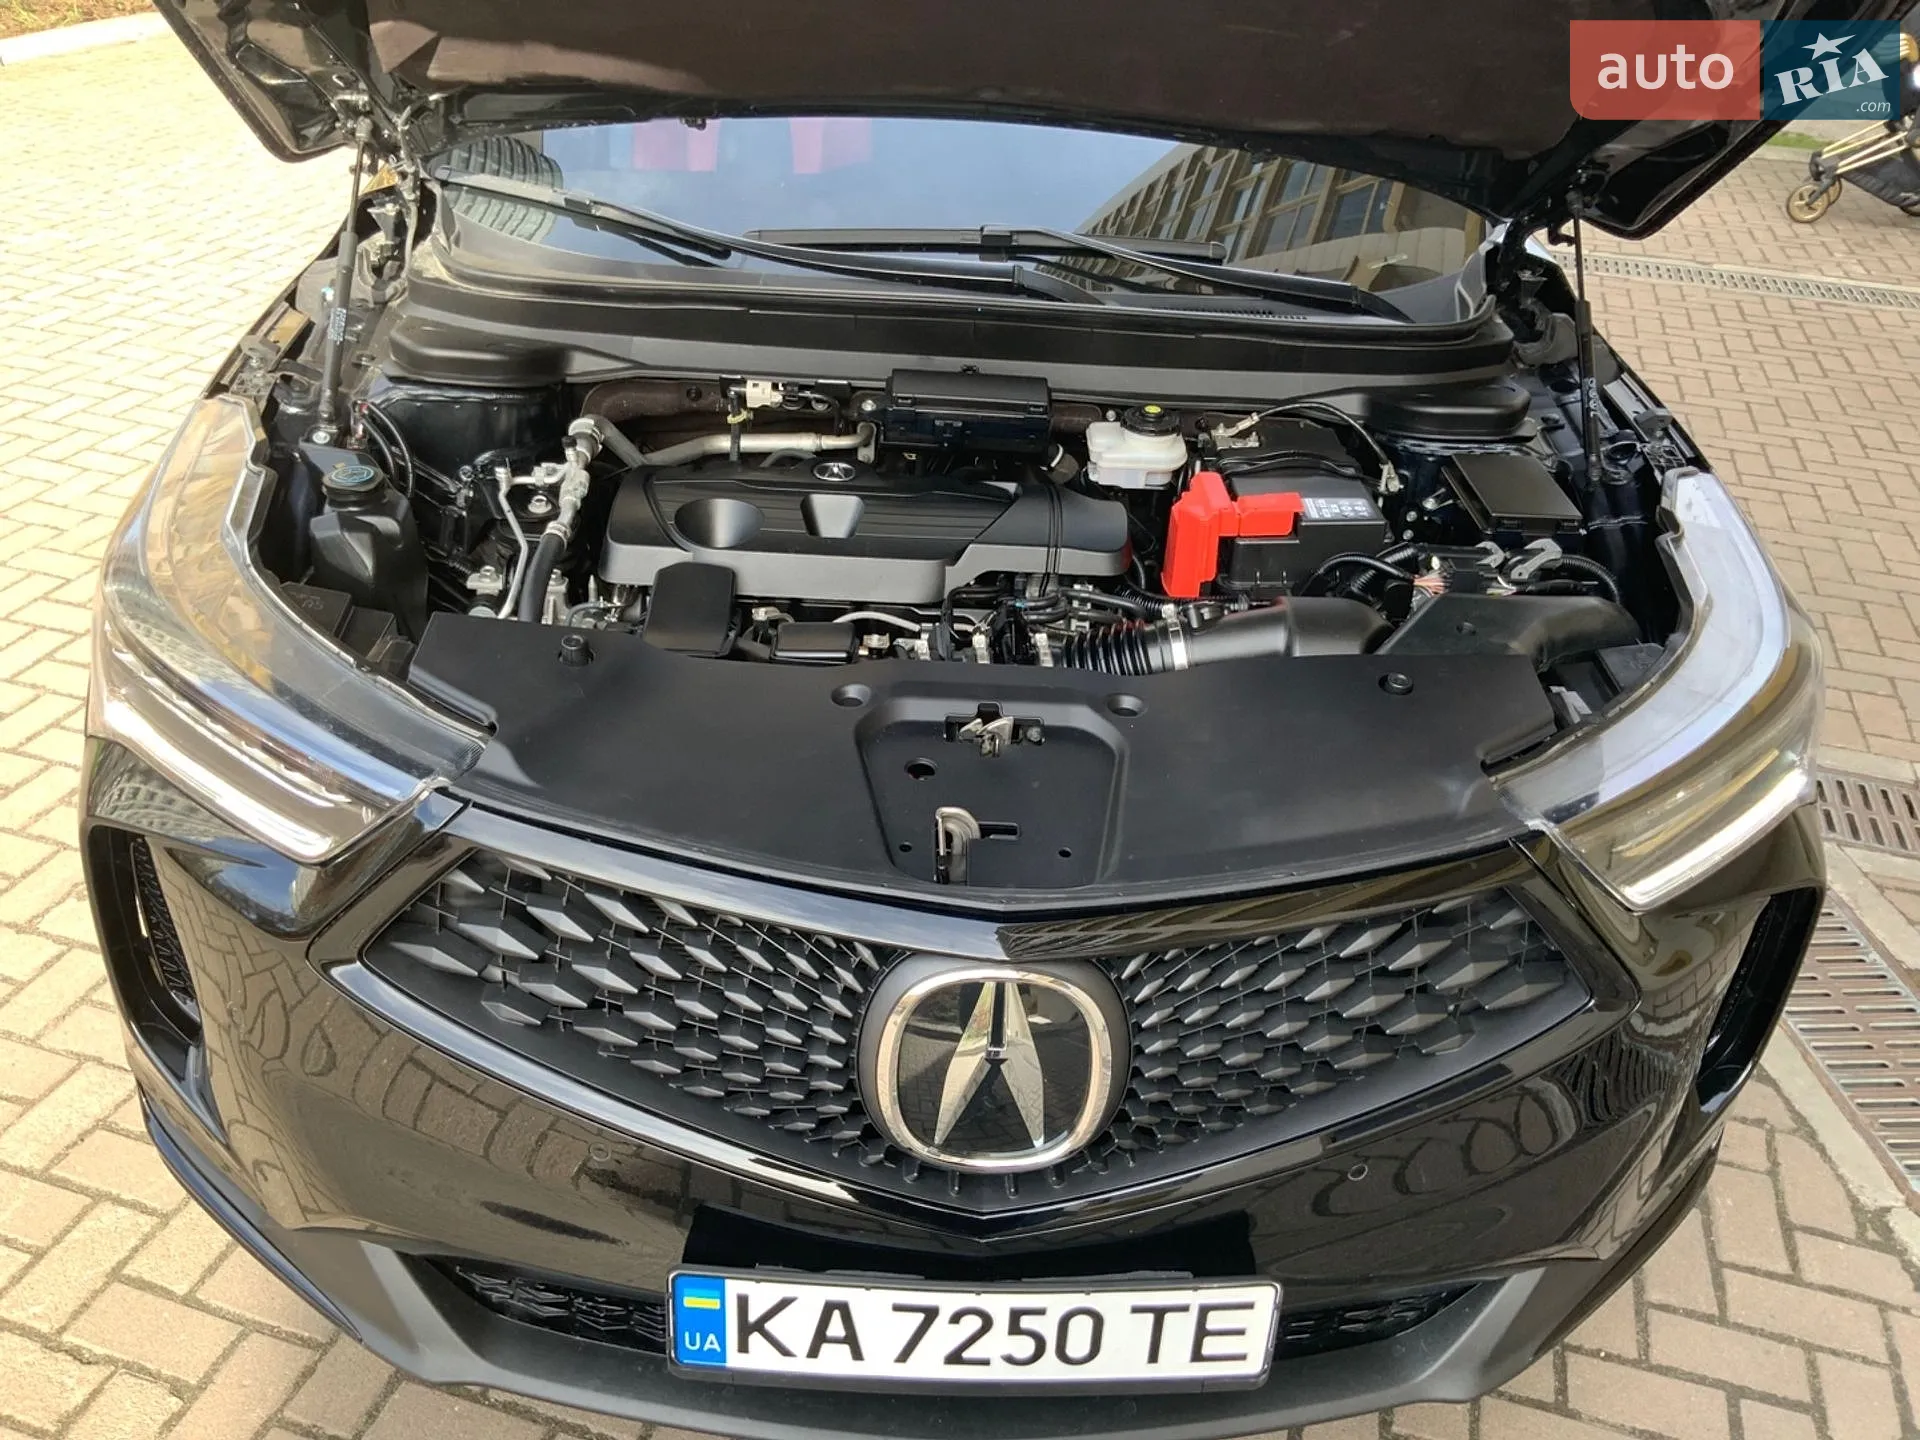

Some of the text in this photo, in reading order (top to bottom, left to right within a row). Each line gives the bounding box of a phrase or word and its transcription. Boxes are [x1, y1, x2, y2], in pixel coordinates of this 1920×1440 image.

[685, 1332, 721, 1352] UA
[735, 1293, 1257, 1366] KA 7250 TE
